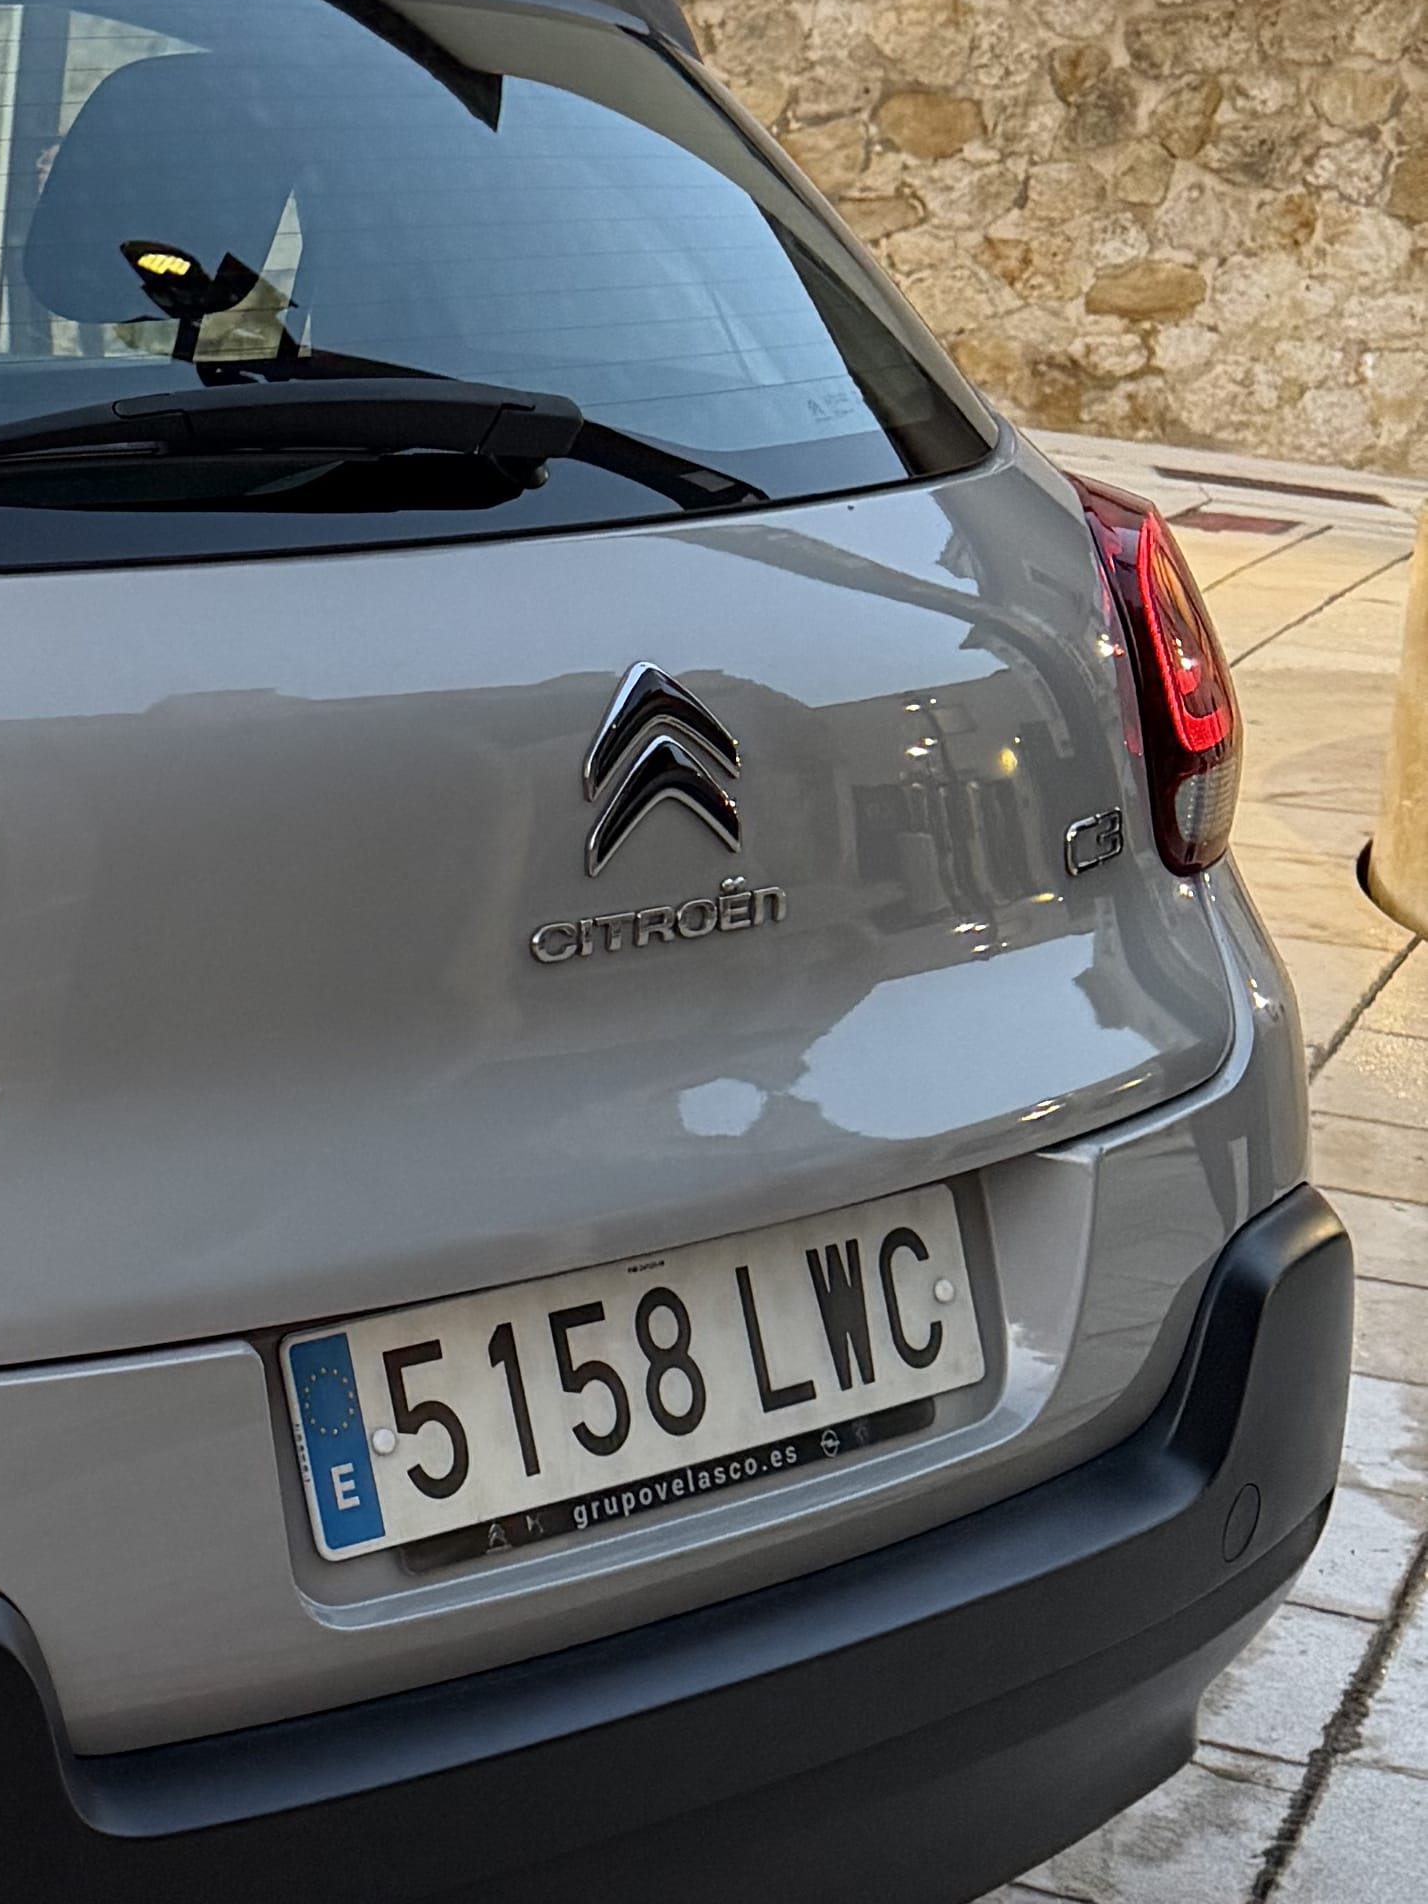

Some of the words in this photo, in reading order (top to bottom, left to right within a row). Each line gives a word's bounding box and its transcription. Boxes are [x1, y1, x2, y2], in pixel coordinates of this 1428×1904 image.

[1063, 805, 1124, 877] C3
[382, 1286, 706, 1500] 5158
[734, 1226, 944, 1413] LWC
[330, 1462, 360, 1511] E
[573, 1443, 799, 1531] grupovelasco.es
